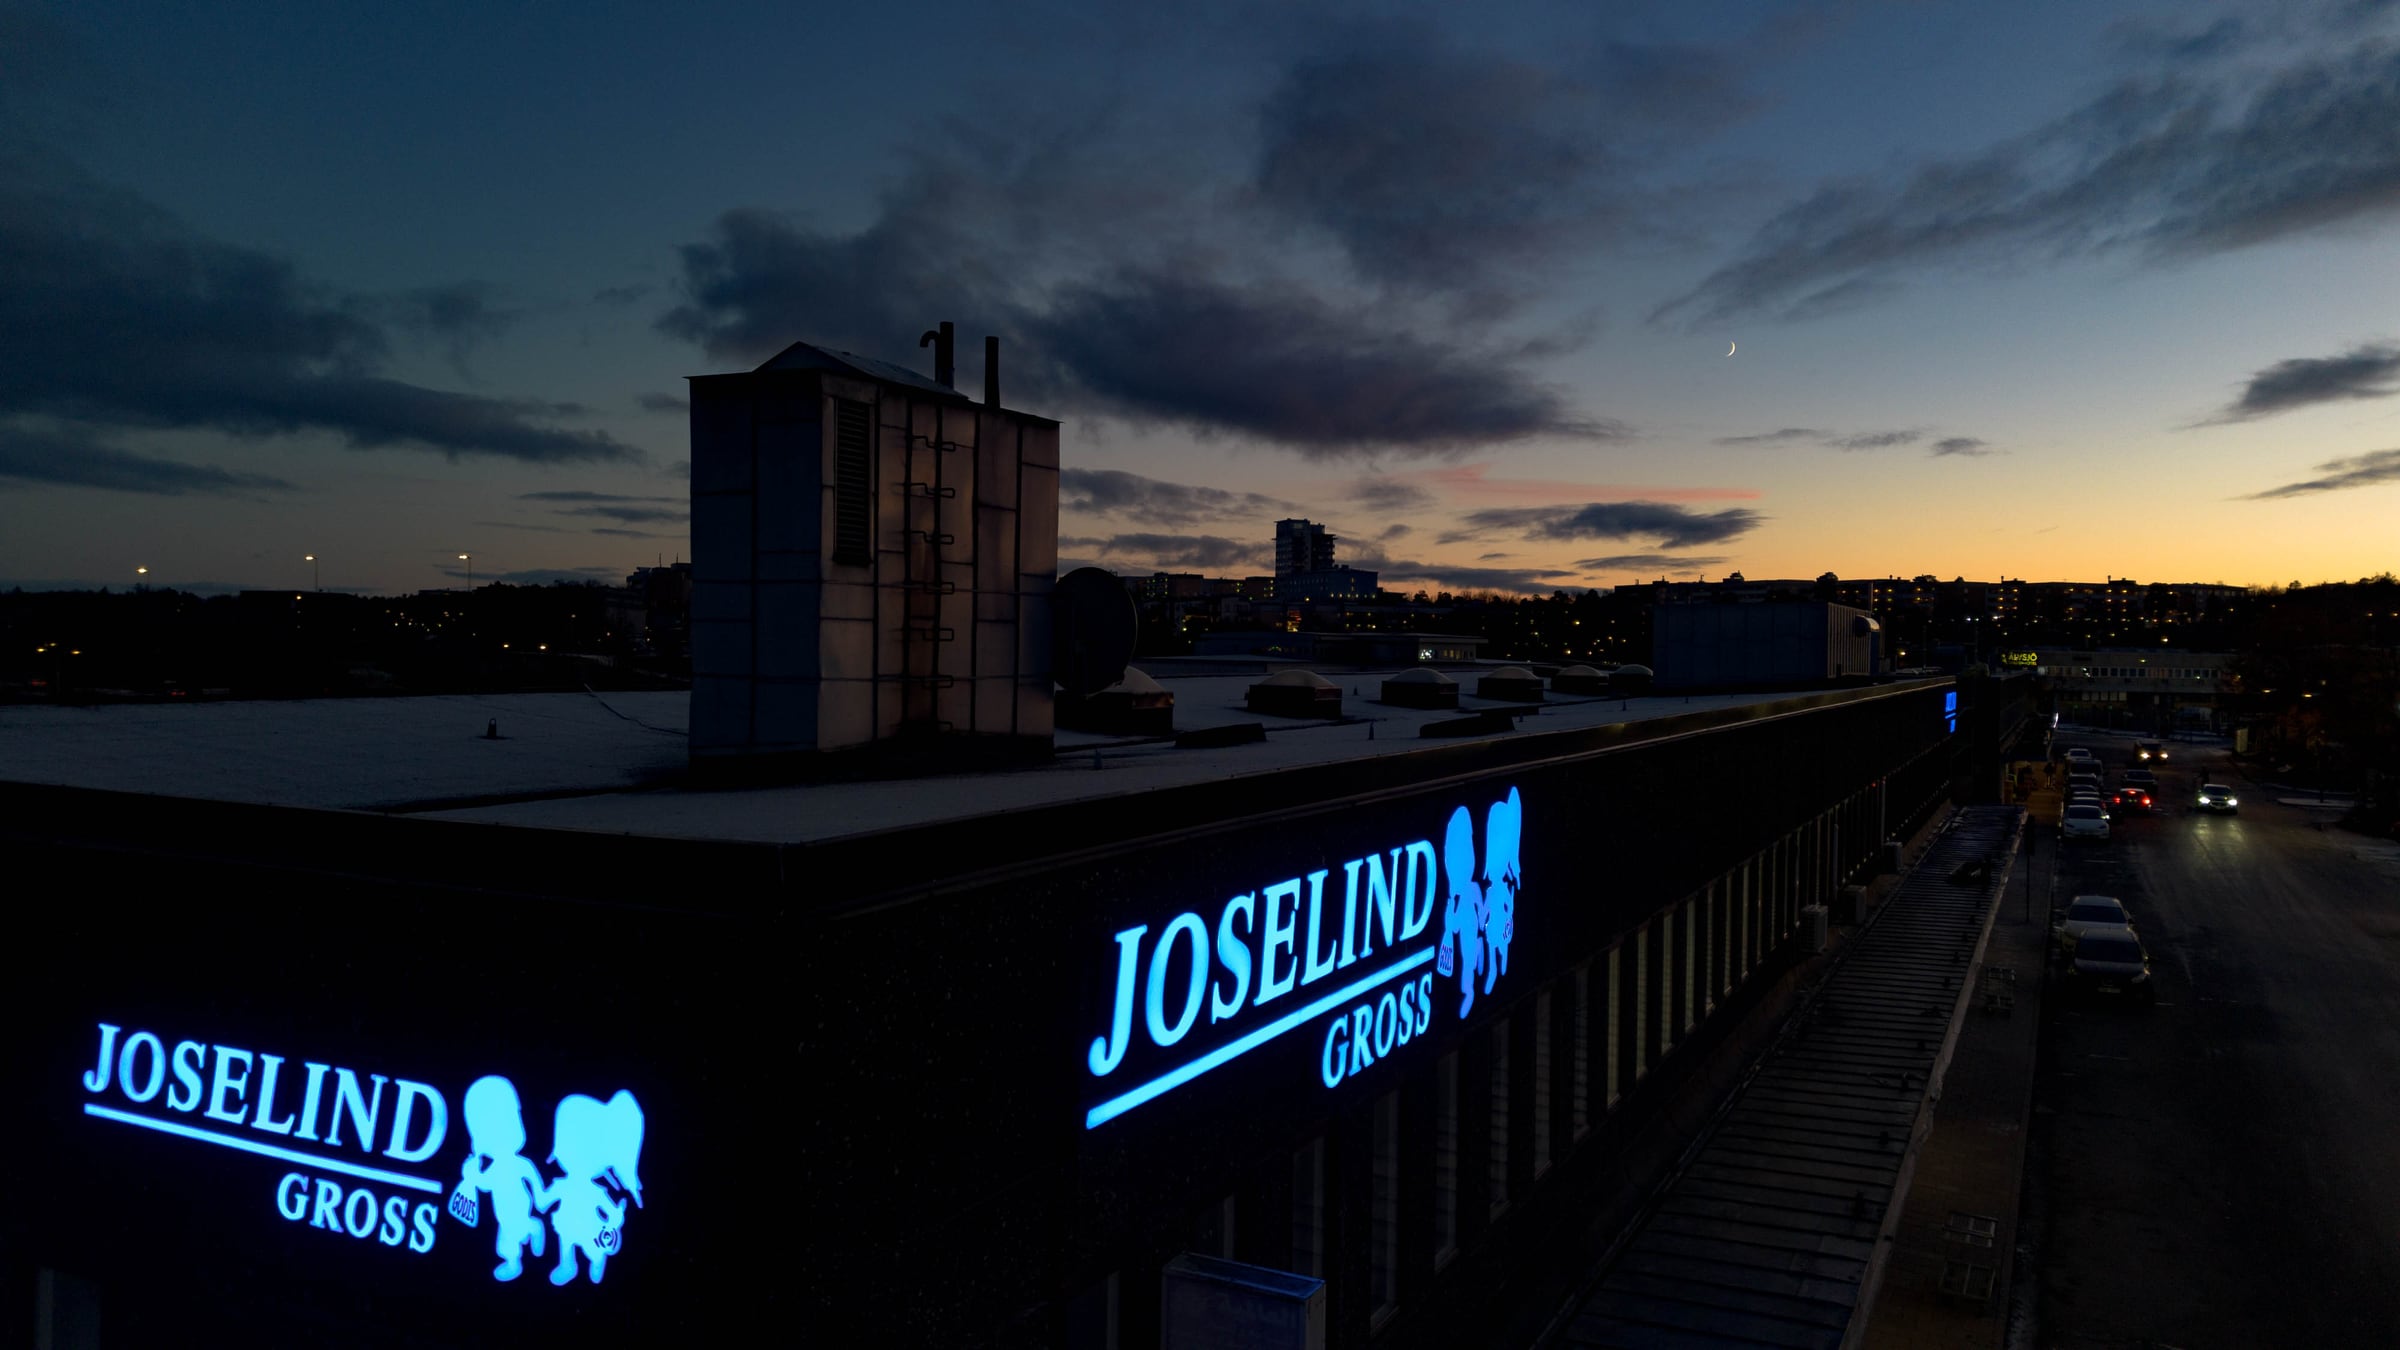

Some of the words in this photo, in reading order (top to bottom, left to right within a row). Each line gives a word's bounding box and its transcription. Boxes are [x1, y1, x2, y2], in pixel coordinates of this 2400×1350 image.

[1088, 840, 1438, 1077] JOSELIND
[83, 1023, 449, 1162] JOSELIND
[1322, 972, 1433, 1088] GROSS
[276, 1172, 439, 1254] GROSS
